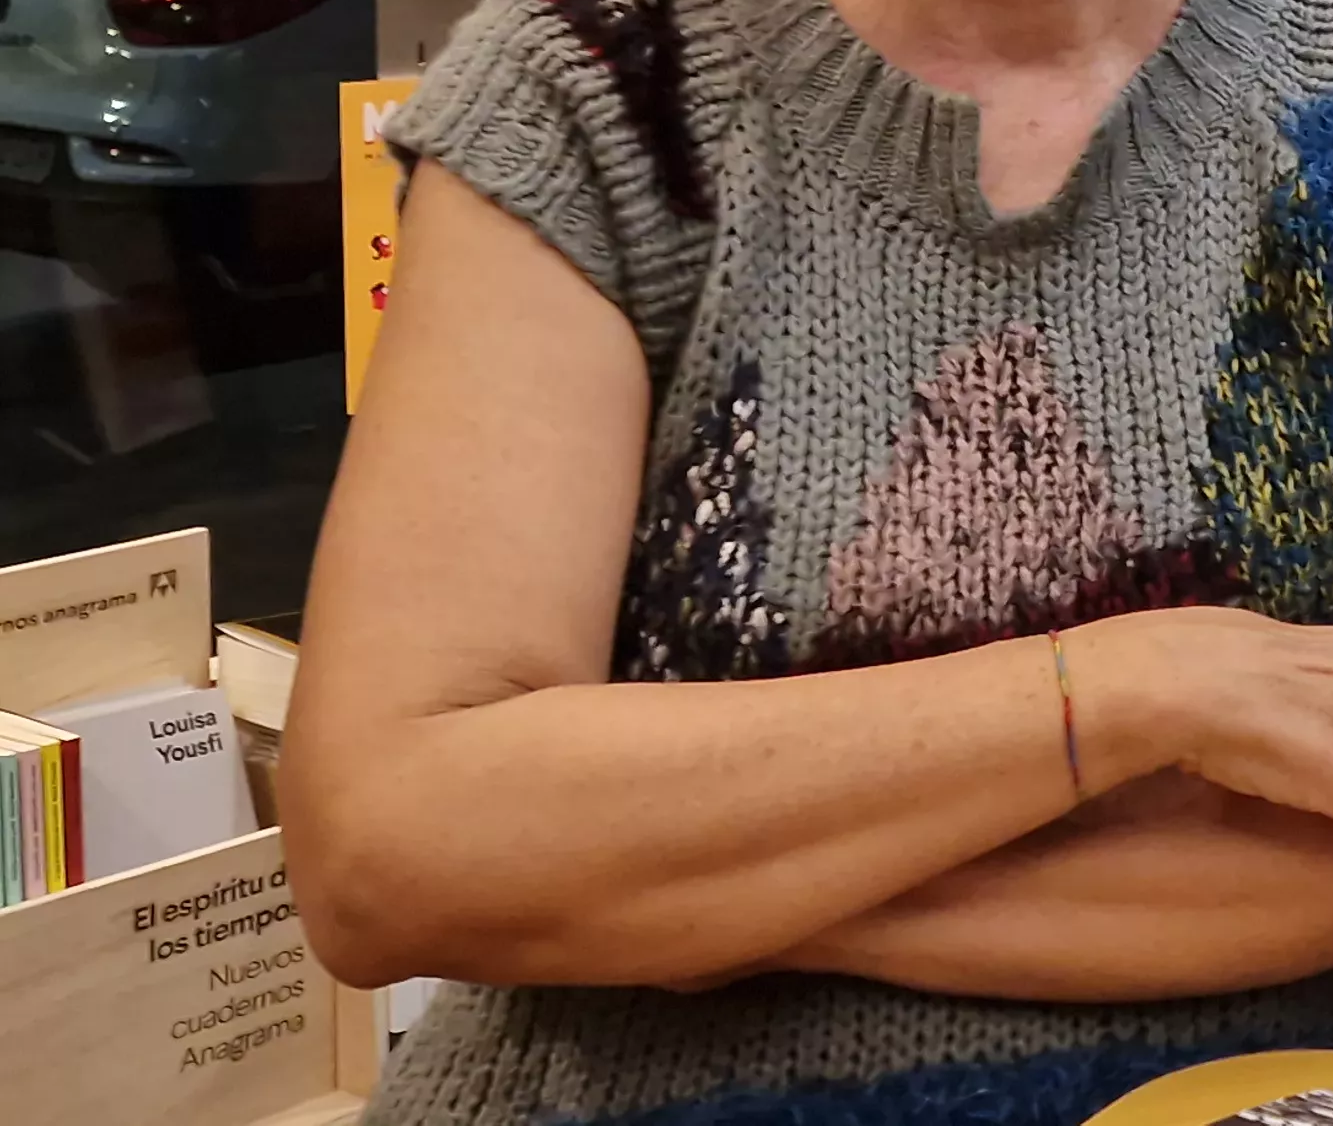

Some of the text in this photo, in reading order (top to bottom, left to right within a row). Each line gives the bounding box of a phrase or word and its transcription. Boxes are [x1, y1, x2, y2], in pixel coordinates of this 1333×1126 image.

[43, 590, 138, 618] anagrama
[149, 707, 218, 741] Louisa
[156, 731, 225, 766] Yousfi
[133, 875, 259, 933] El espíritu
[149, 932, 191, 964] los
[208, 941, 305, 993] Nuevos
[170, 976, 305, 1040] cuadernos
[179, 1013, 306, 1074] Anagrama
